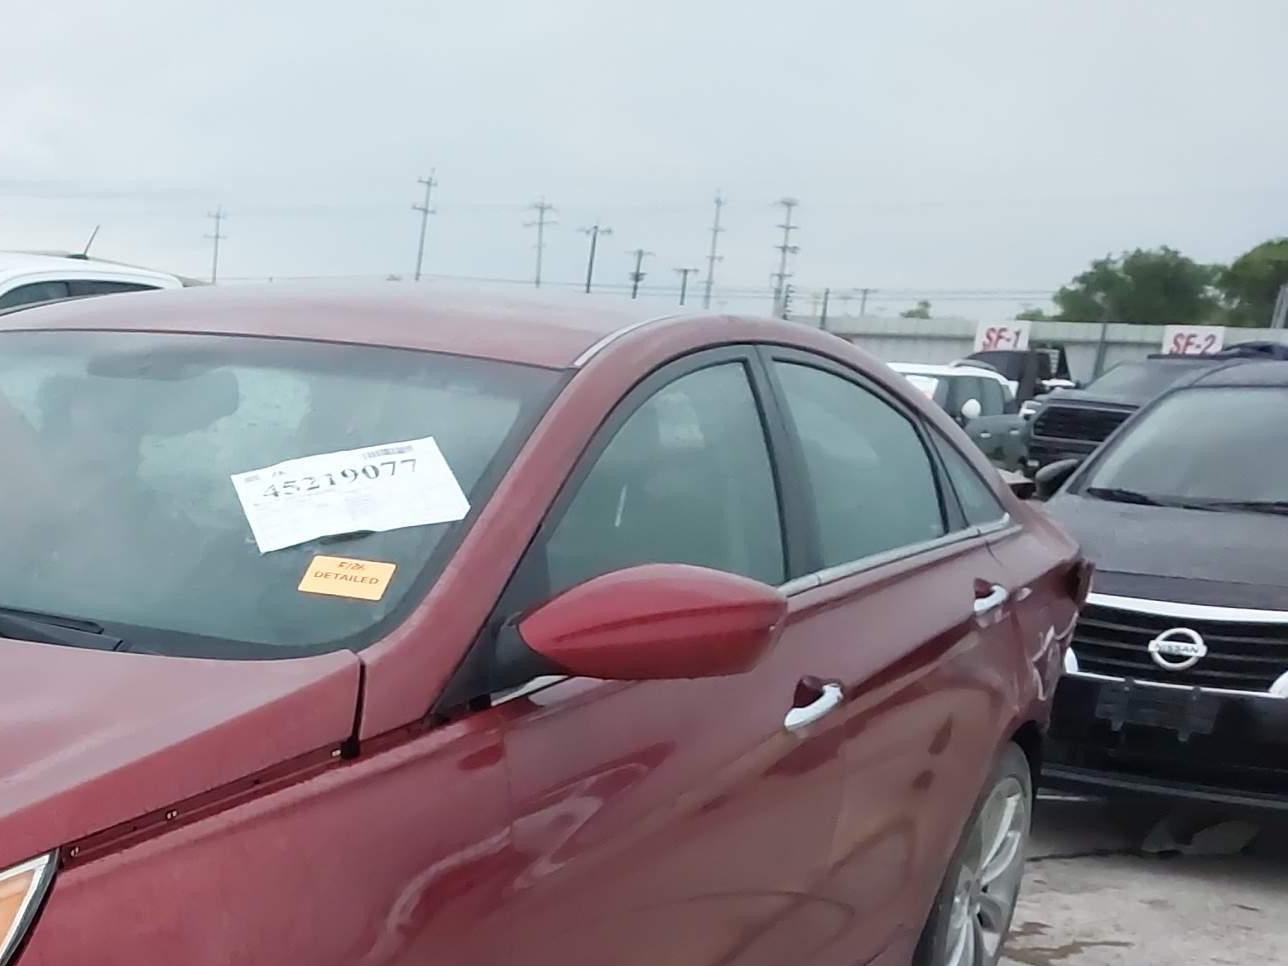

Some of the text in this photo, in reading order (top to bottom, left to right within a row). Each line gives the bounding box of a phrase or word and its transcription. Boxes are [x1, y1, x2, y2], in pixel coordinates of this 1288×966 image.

[982, 327, 1022, 351] SF-1
[1170, 333, 1216, 355] SF-2
[263, 459, 416, 497] 45219077
[313, 570, 380, 585] DETAILED
[1155, 642, 1199, 654] NISSAN
